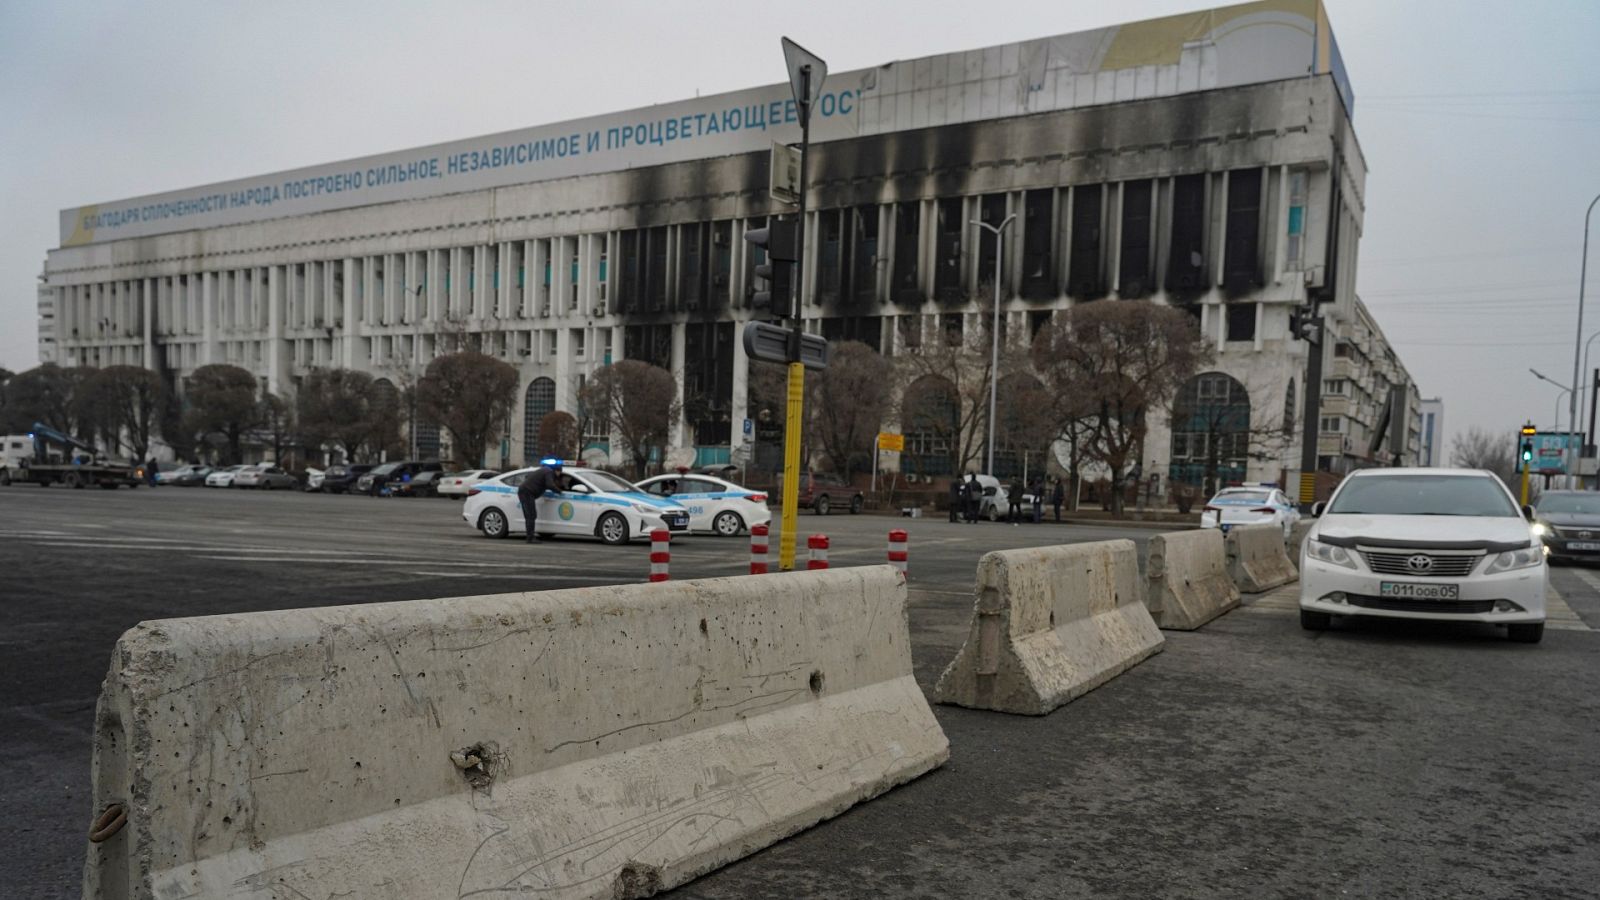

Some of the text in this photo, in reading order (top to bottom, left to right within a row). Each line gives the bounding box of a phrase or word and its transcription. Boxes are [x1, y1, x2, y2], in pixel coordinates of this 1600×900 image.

[83, 88, 861, 230] БЛАГОДАРЯ СПЛОЧЕННОСТИ НАРОДА ПОСТРОЕНО СИЛЬНОЕ, НЕЗАВИСИМОЕ И ПРОЦВЕТАЮЩЕЕ ОС
[1393, 584, 1414, 595] 011
[1440, 587, 1456, 597] 05
